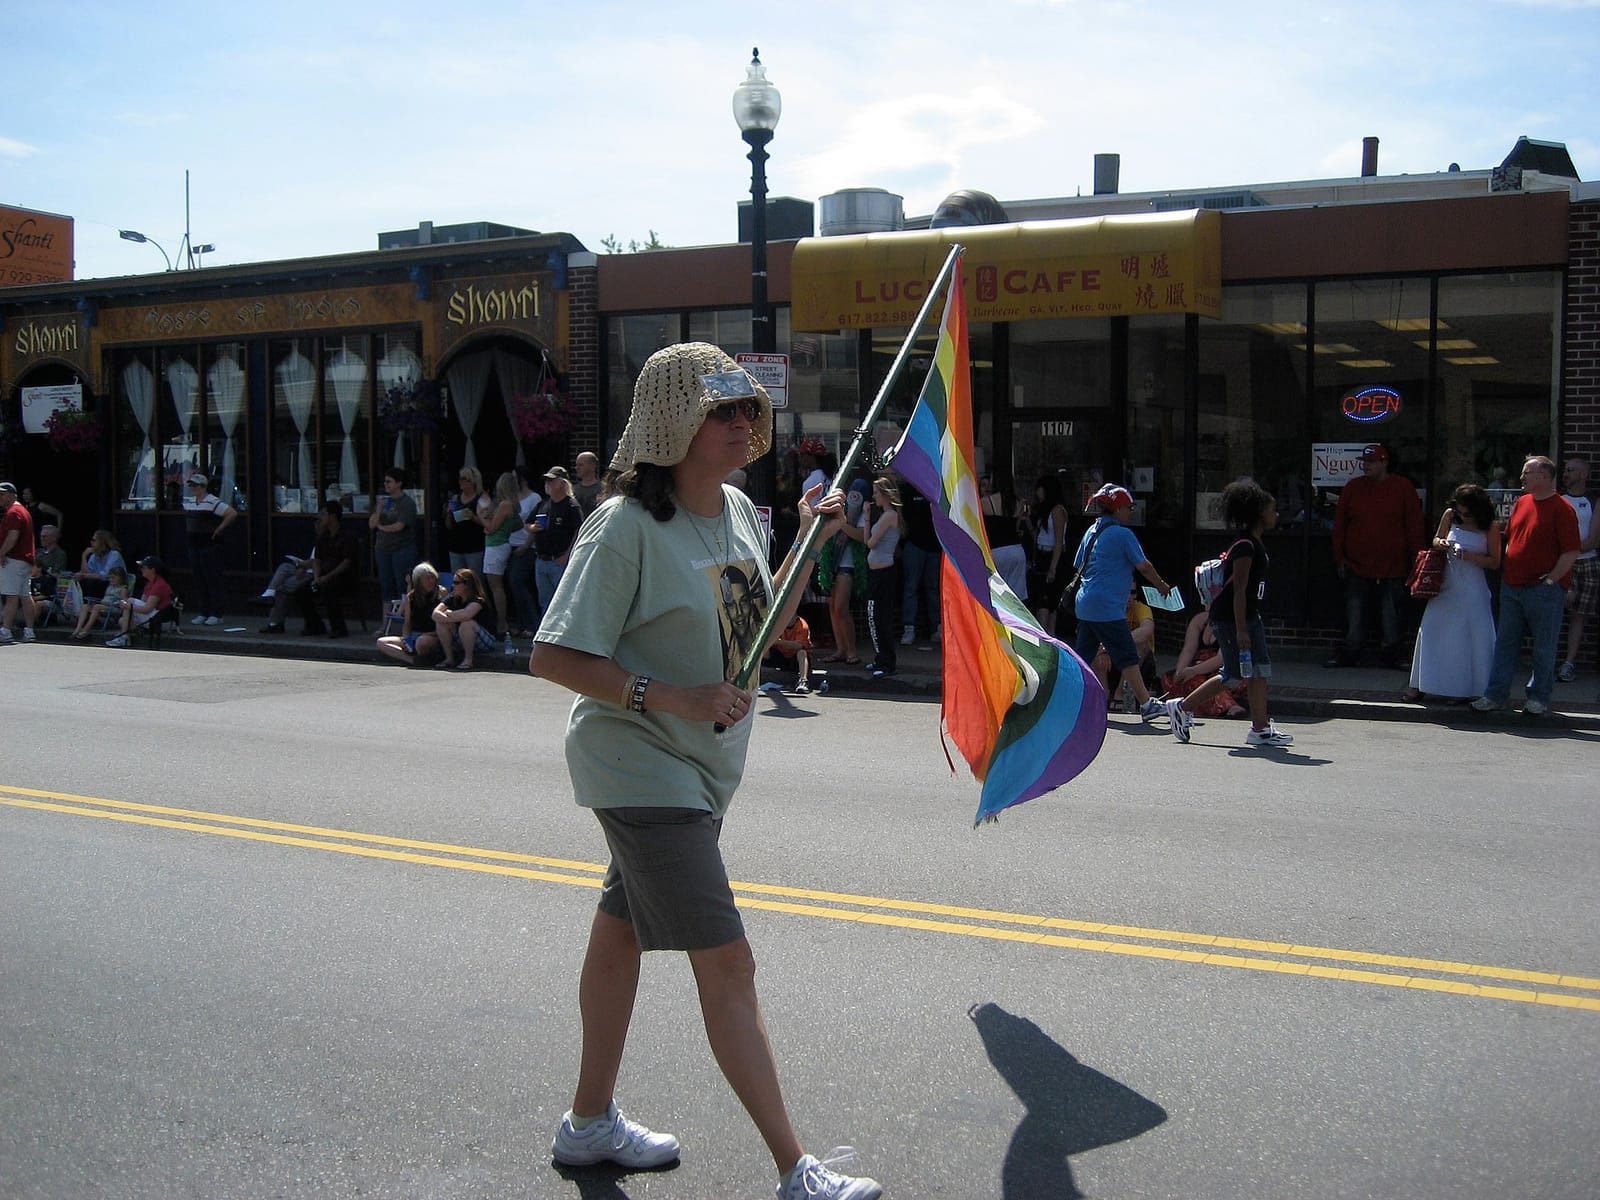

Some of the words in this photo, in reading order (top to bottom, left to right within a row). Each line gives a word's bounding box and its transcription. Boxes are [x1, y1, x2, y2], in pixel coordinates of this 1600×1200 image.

[0, 219, 54, 259] Shanti
[447, 280, 540, 324] Shanti
[855, 278, 968, 303] LUC
[1003, 269, 1102, 295] CAFE
[838, 311, 918, 325] 617.822.988
[16, 319, 78, 353] Shanti
[1342, 395, 1400, 414] OPEN
[1044, 422, 1072, 435] 1107
